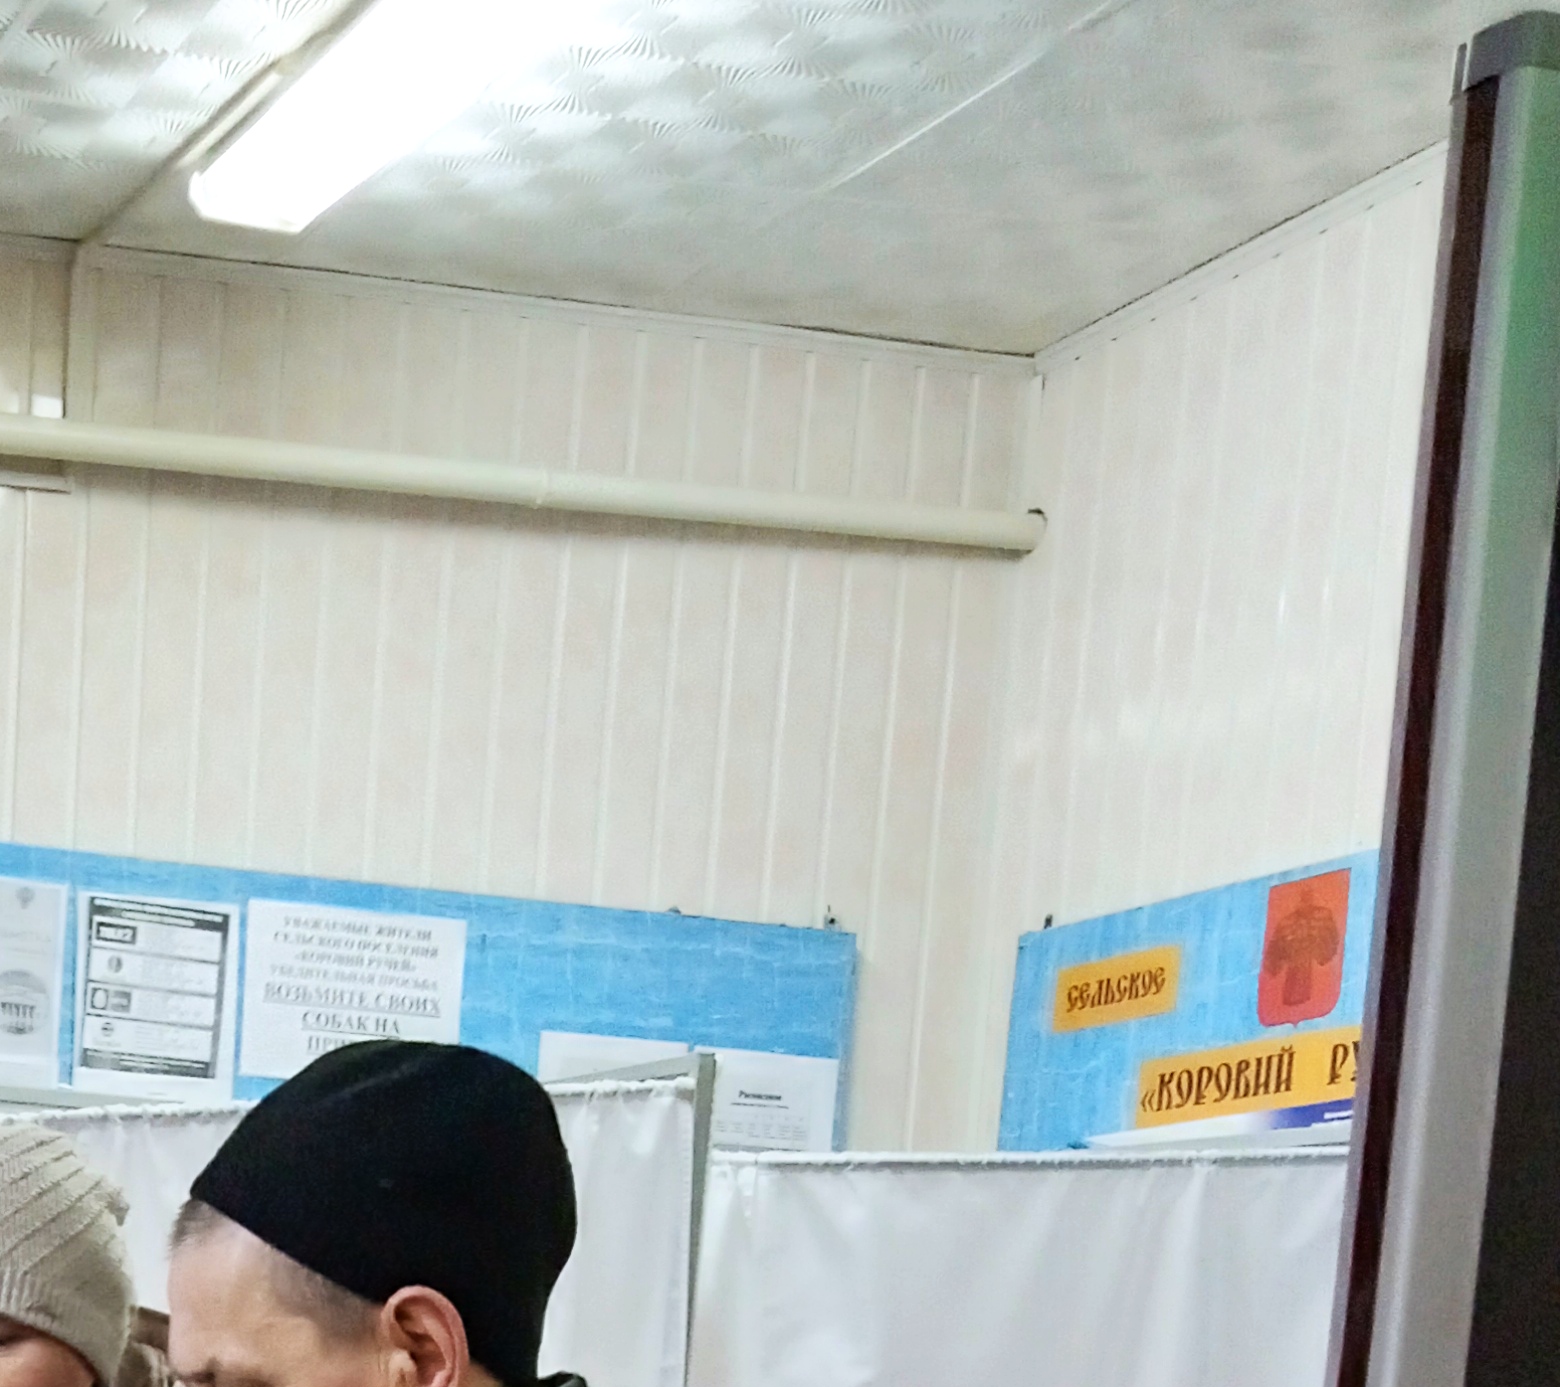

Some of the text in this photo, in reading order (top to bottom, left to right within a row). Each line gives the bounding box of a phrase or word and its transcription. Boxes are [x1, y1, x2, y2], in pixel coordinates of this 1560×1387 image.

[264, 982, 440, 1015] ВОЗЬМИТЕ СВОИХ
[1066, 966, 1166, 1013] СЕЛЬСКОЕ
[302, 1010, 400, 1034] СОБАК НА
[1141, 1045, 1296, 1113] «КОРОВИЙ
